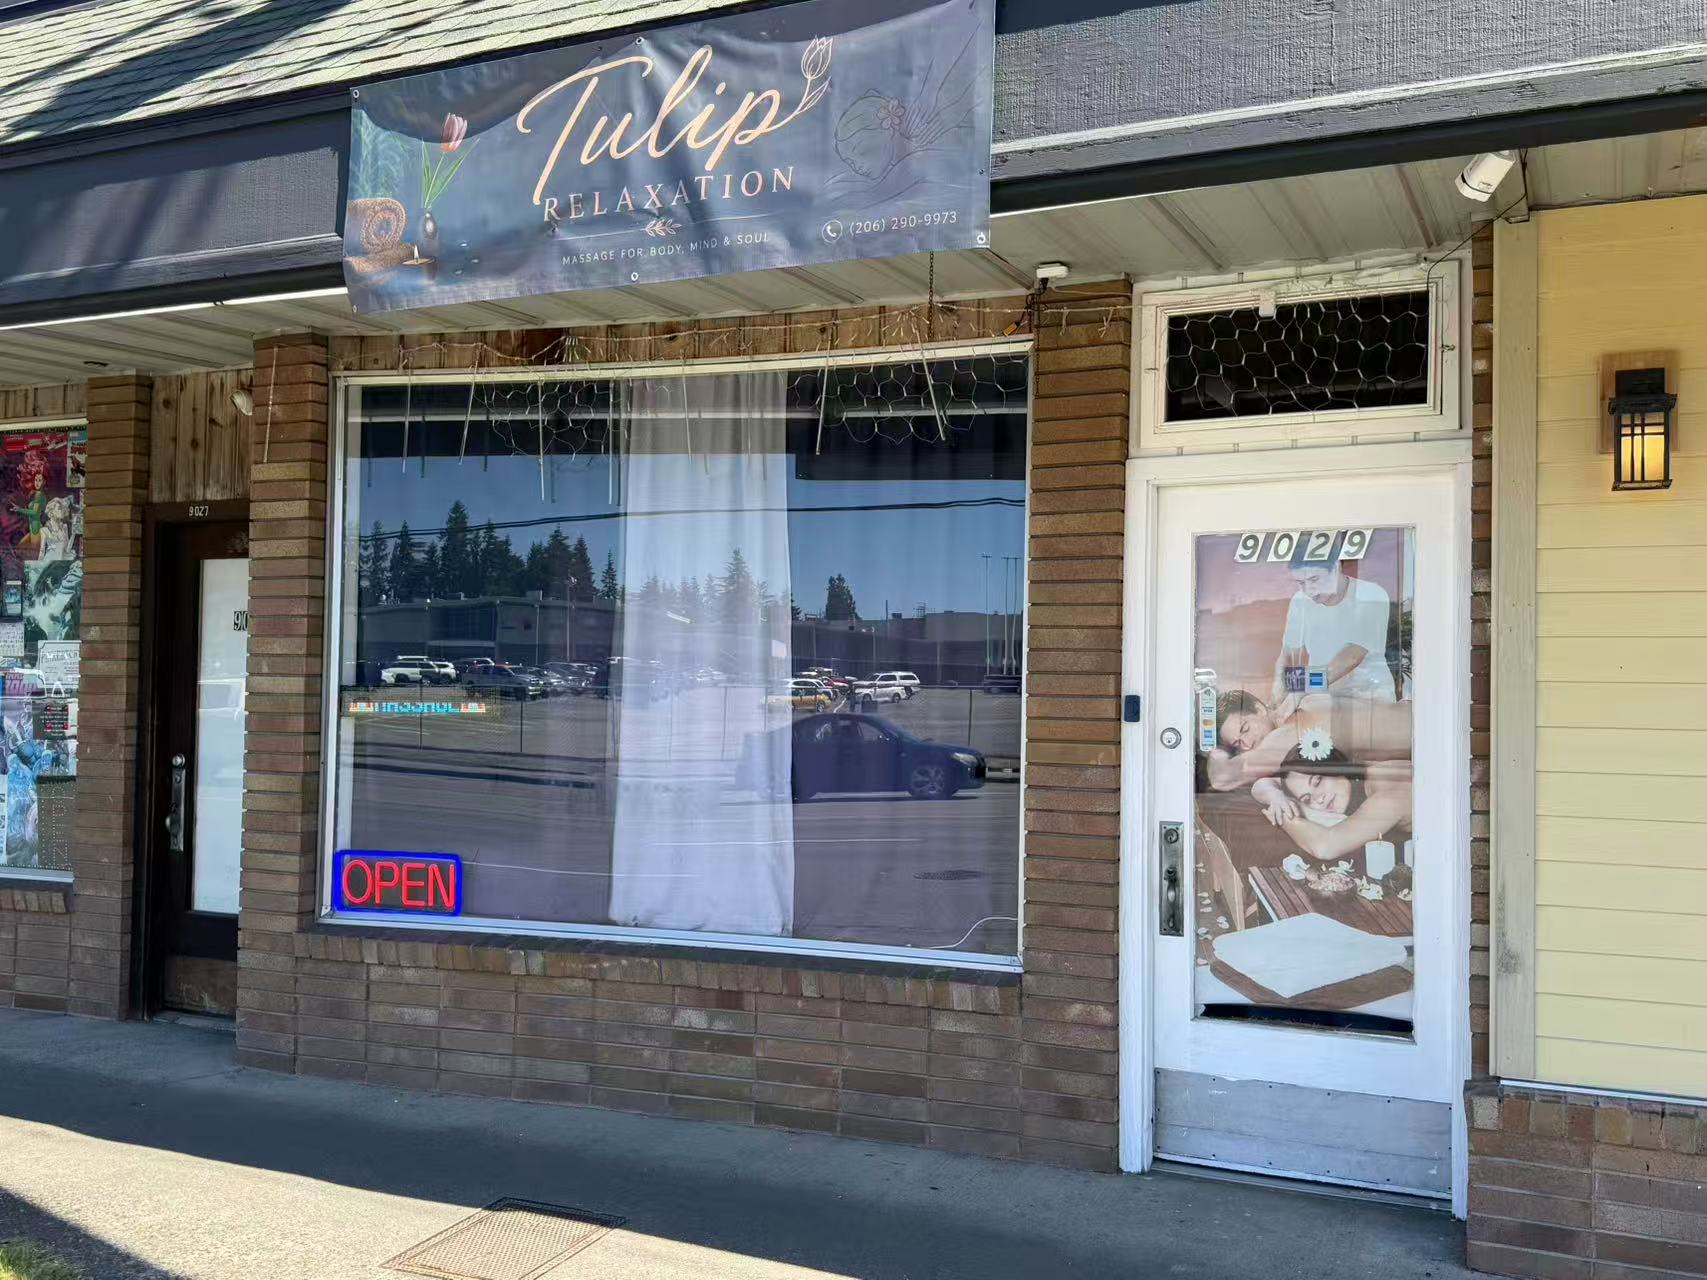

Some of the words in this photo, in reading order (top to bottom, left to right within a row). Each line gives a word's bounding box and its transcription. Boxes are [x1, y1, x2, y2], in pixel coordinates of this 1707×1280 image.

[516, 45, 788, 205] Tulip
[543, 166, 794, 221] RELAXATION
[849, 218, 886, 236] (206)
[891, 210, 957, 230] 290-9973
[562, 251, 615, 266] MASSAGE
[621, 249, 643, 259] FOR
[650, 245, 685, 256] BODY,
[690, 238, 718, 251] MIND
[723, 236, 730, 246] &
[737, 233, 769, 245] SOUL
[188, 505, 209, 517] 9027
[1238, 530, 1367, 560] 9029
[342, 859, 456, 909] OPEN
